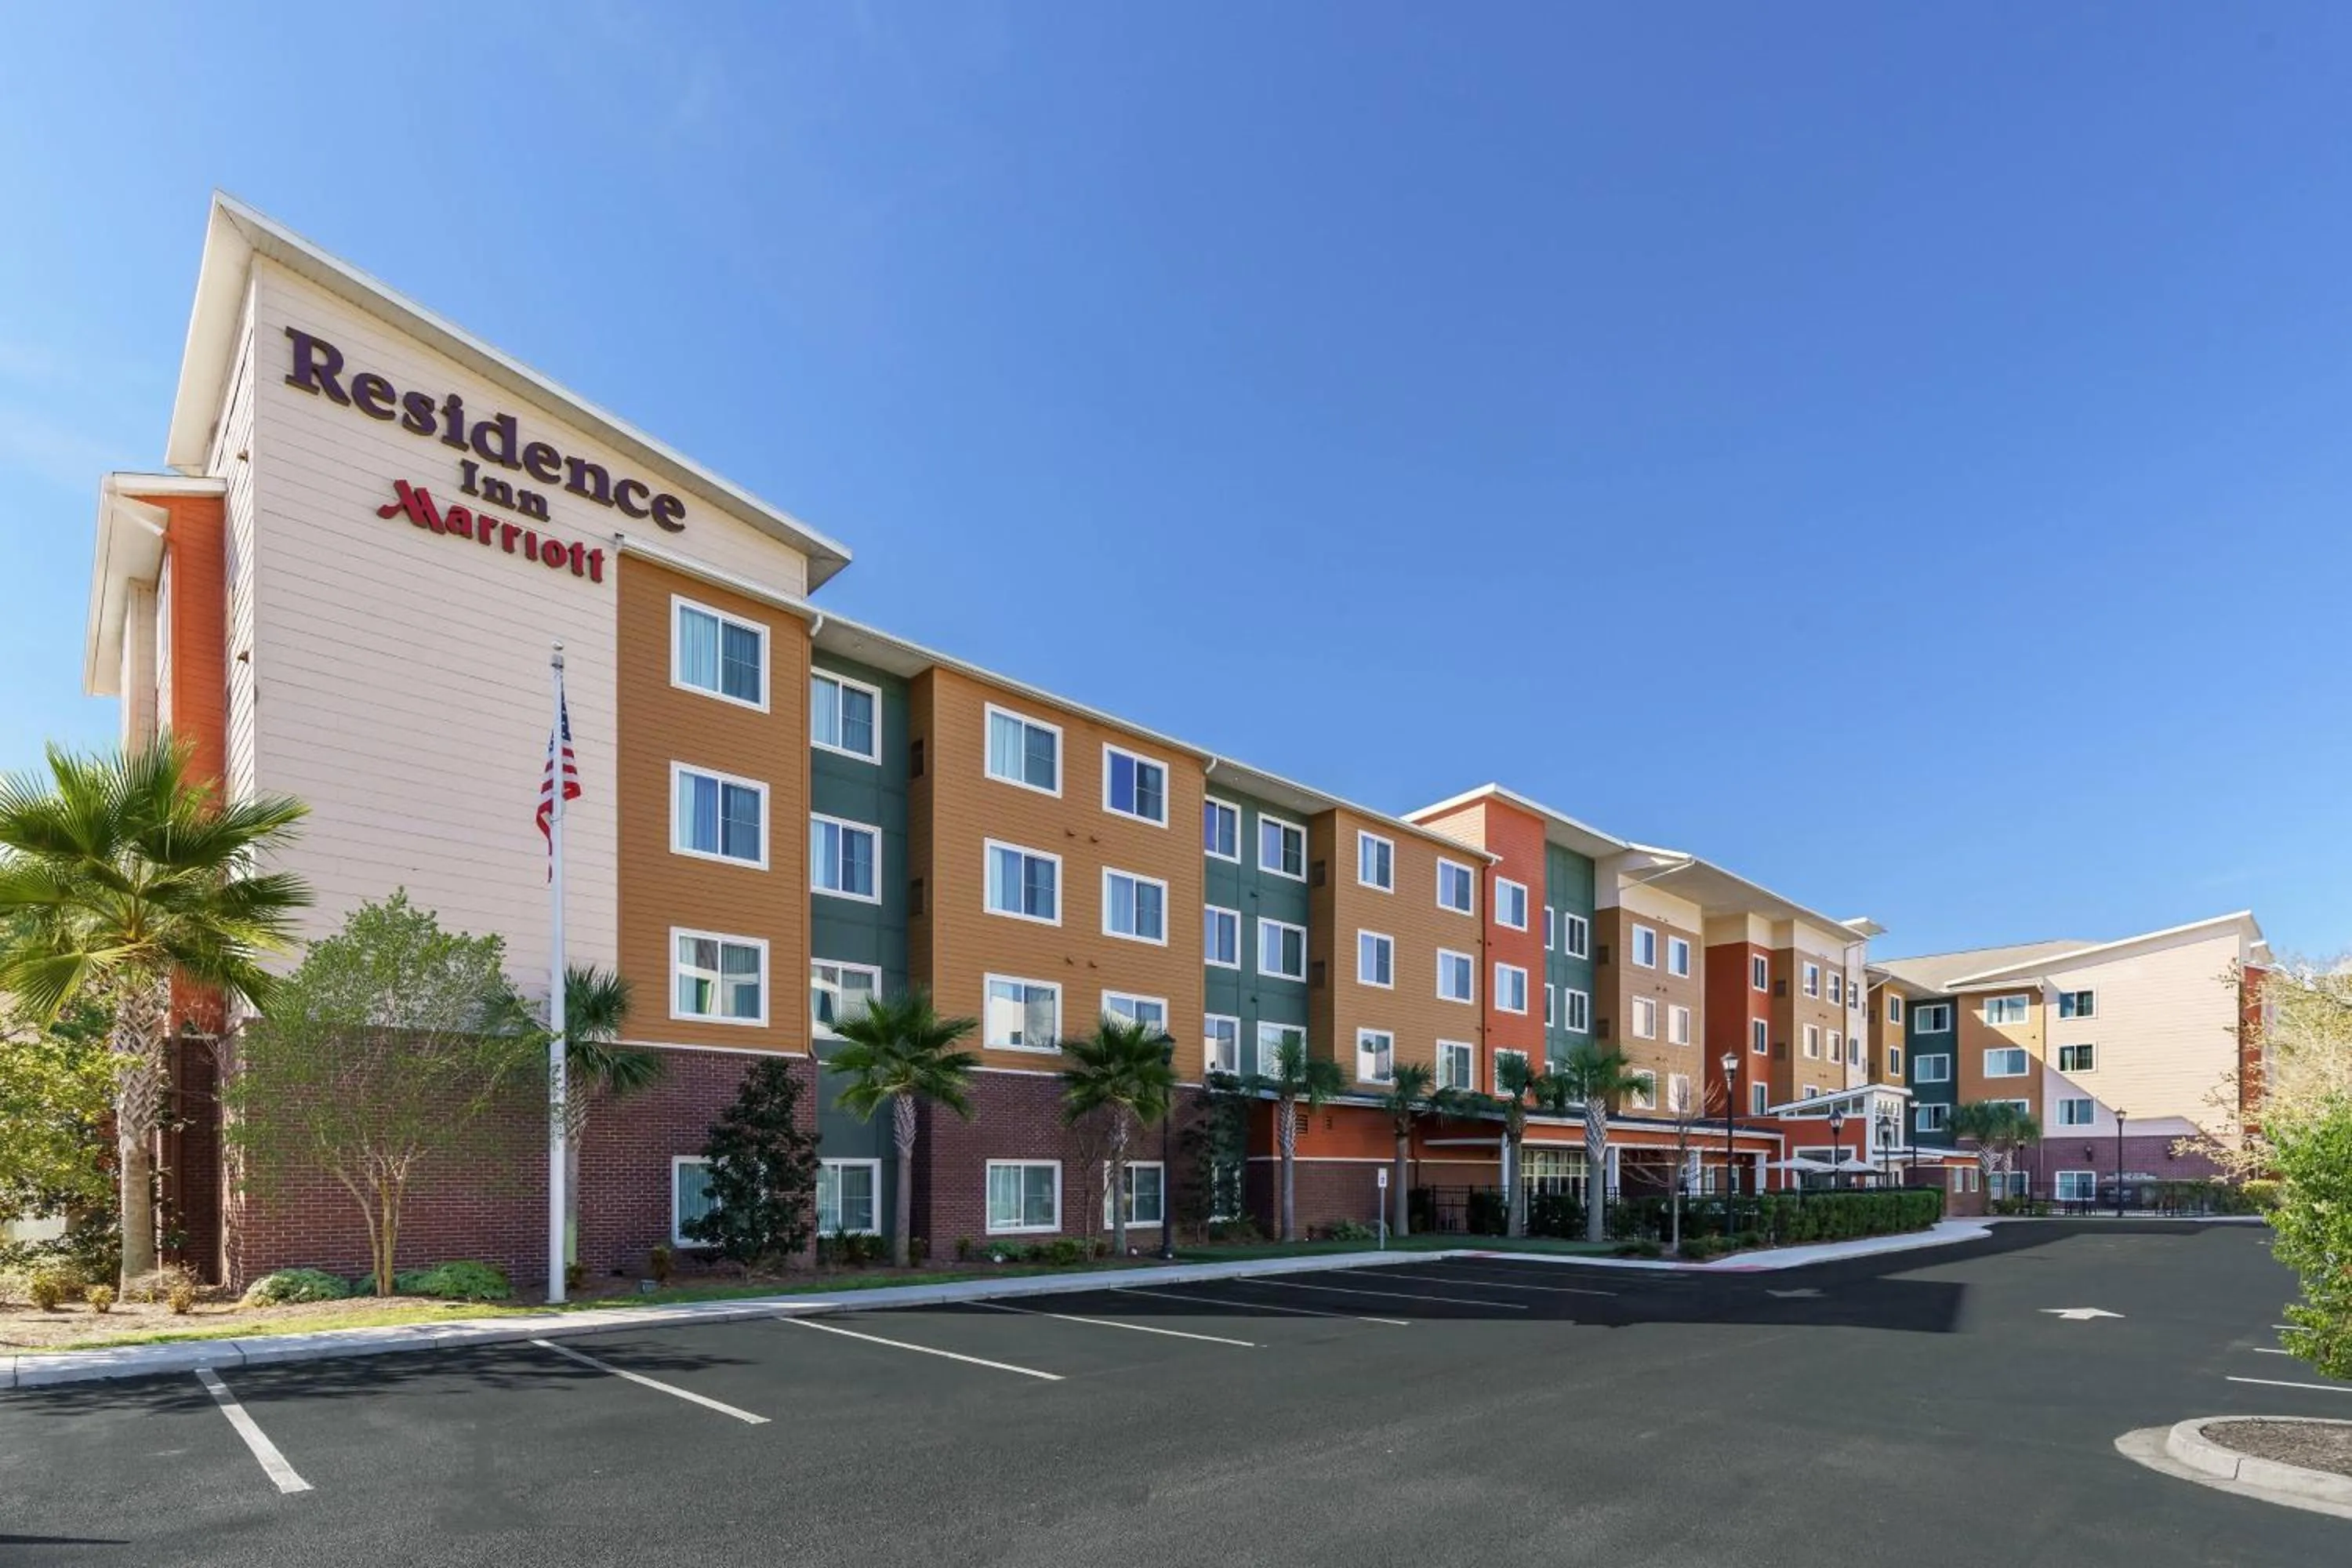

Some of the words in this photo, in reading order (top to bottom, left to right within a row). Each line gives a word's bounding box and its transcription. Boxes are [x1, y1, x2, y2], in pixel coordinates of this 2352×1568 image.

[285, 325, 687, 533] Residence
[376, 478, 604, 584] Marriott
[459, 458, 551, 522] Inn
